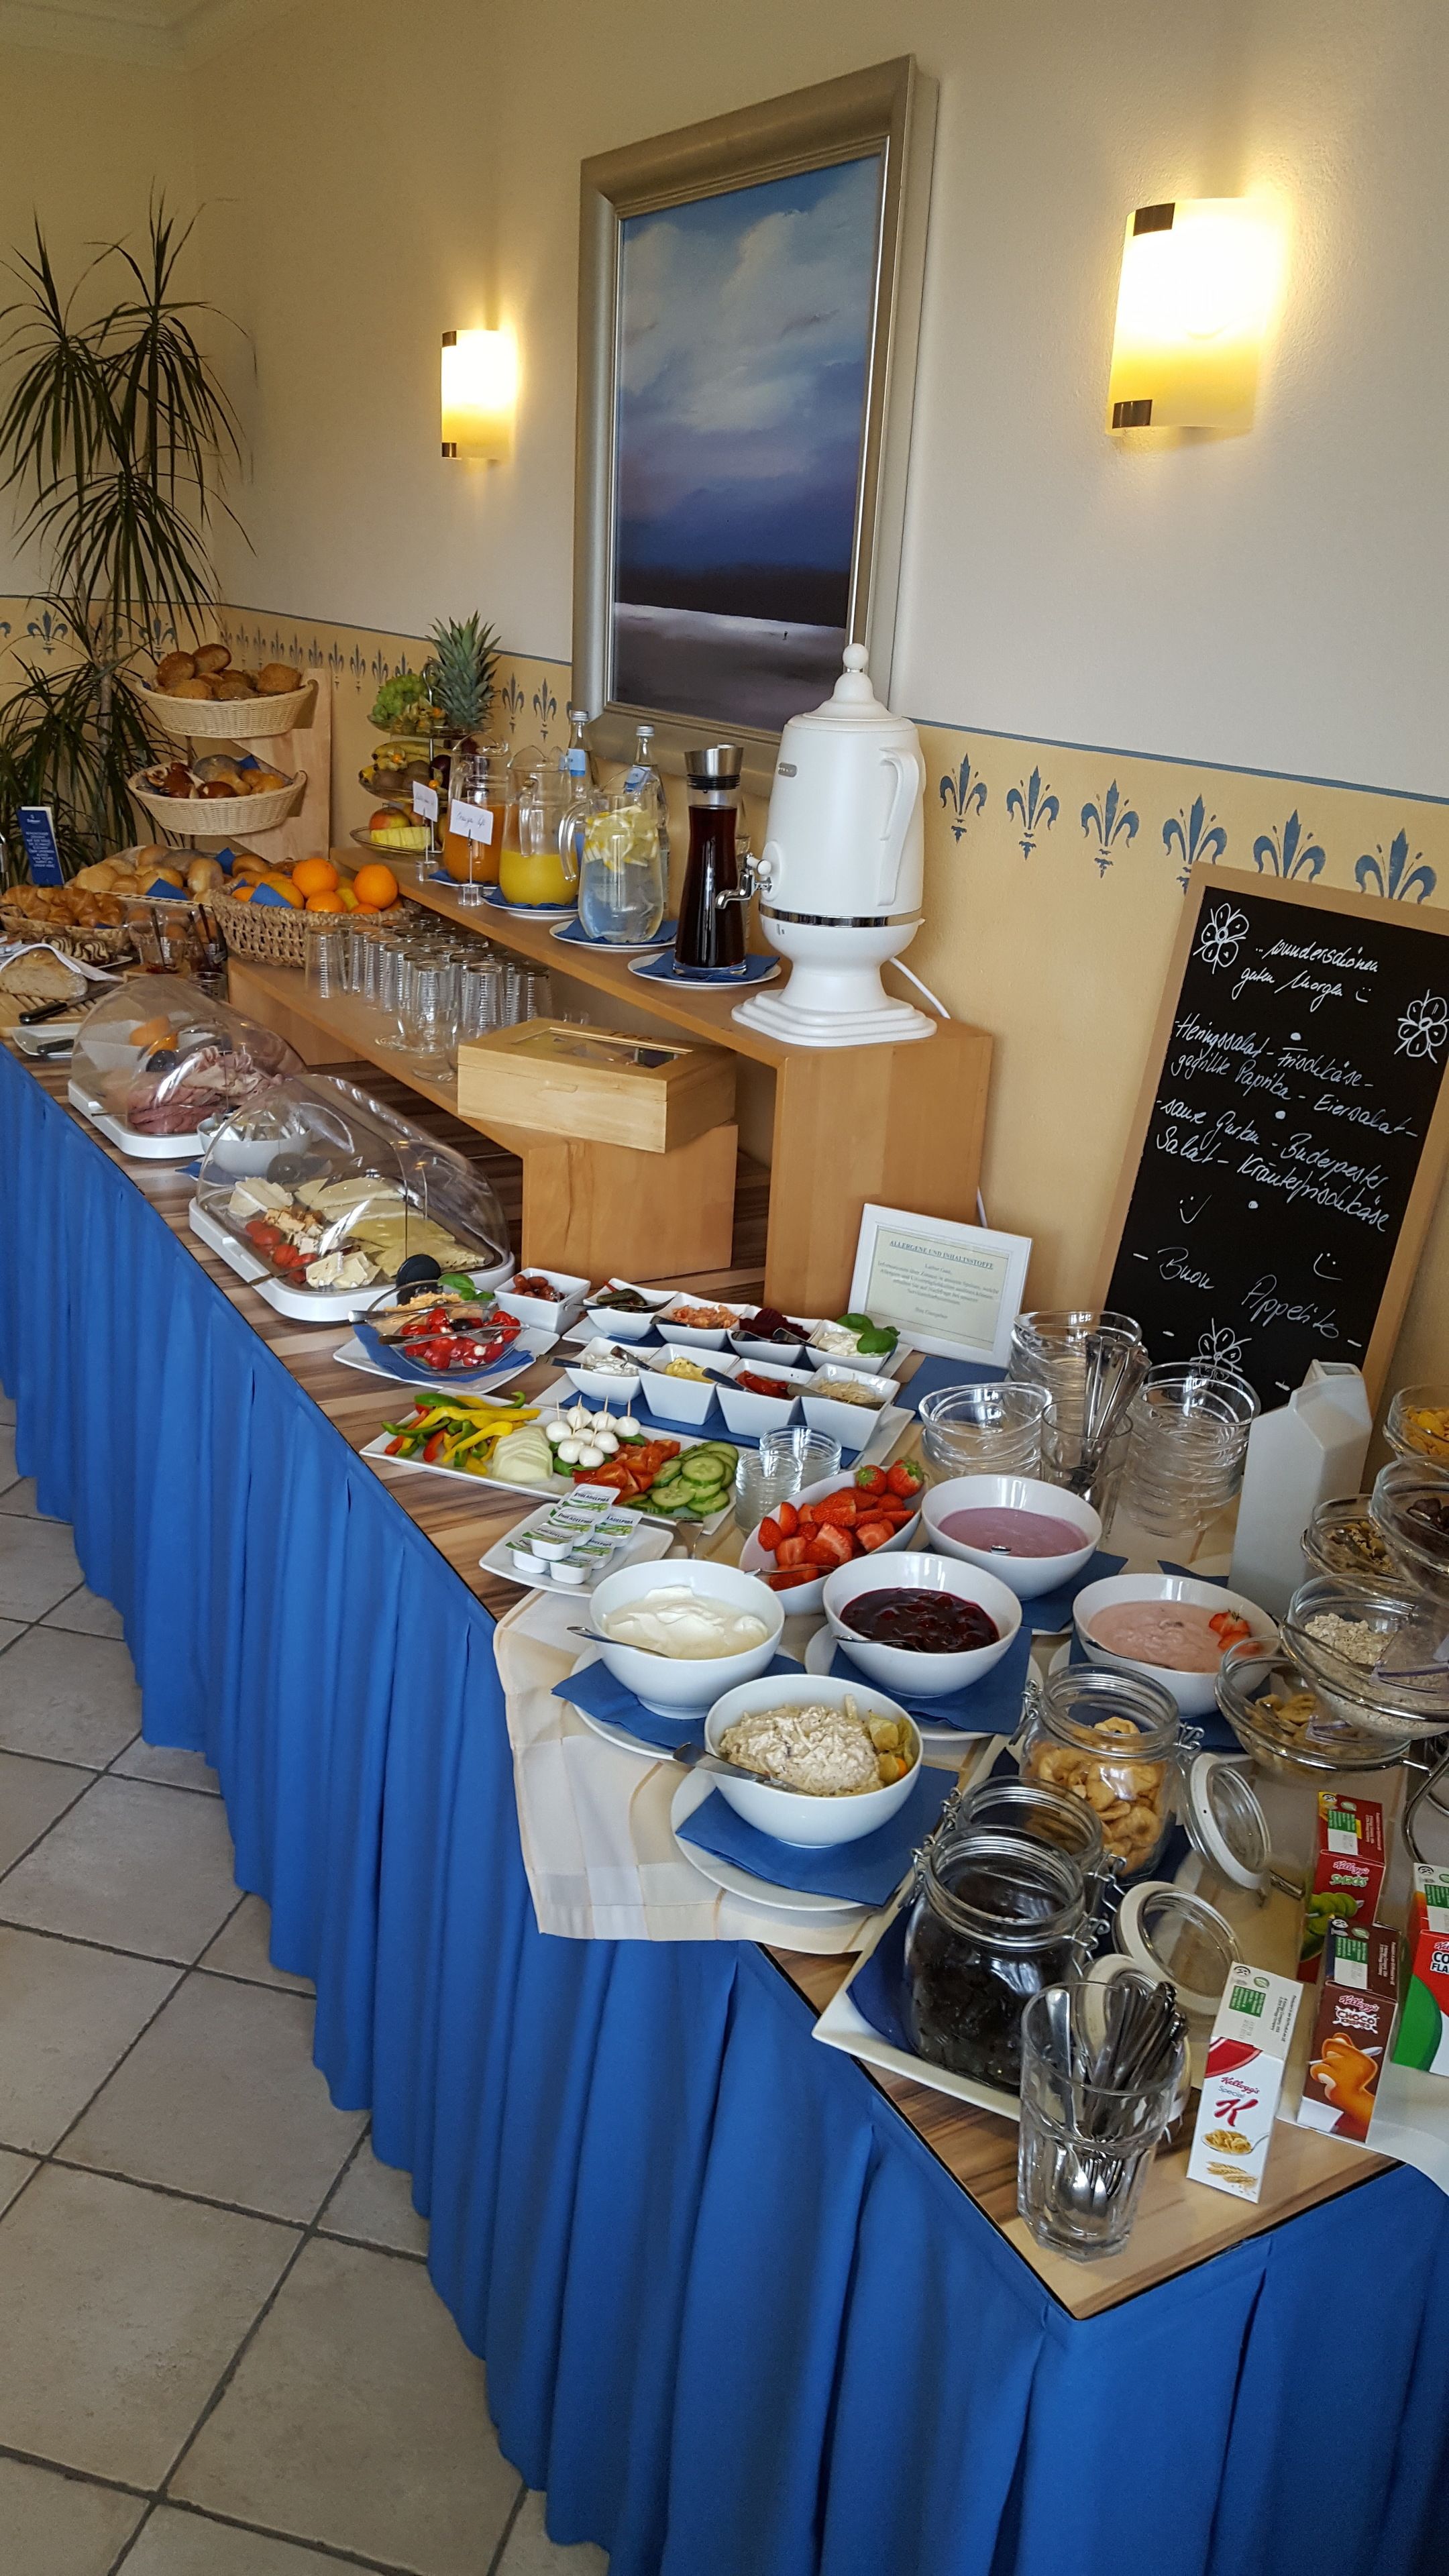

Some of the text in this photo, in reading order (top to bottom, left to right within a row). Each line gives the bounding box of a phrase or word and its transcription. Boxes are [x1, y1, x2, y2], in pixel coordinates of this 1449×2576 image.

[1274, 970, 1343, 1012] Morgen
[1234, 1059, 1291, 1097] Paprika
[1199, 1110, 1260, 1151] Gurken
[1157, 1126, 1222, 1164] Salat
[890, 1240, 928, 1255] ALLERGENE
[606, 1515, 633, 1524] LADELPHIA
[1433, 1951, 1449, 1964] CO
[1431, 1962, 1449, 1973] FLA
[1338, 2010, 1376, 2025] CHOCO
[1218, 2085, 1246, 2098] Special
[1221, 2077, 1260, 2094] Kellogg's
[1214, 2098, 1258, 2127] K
